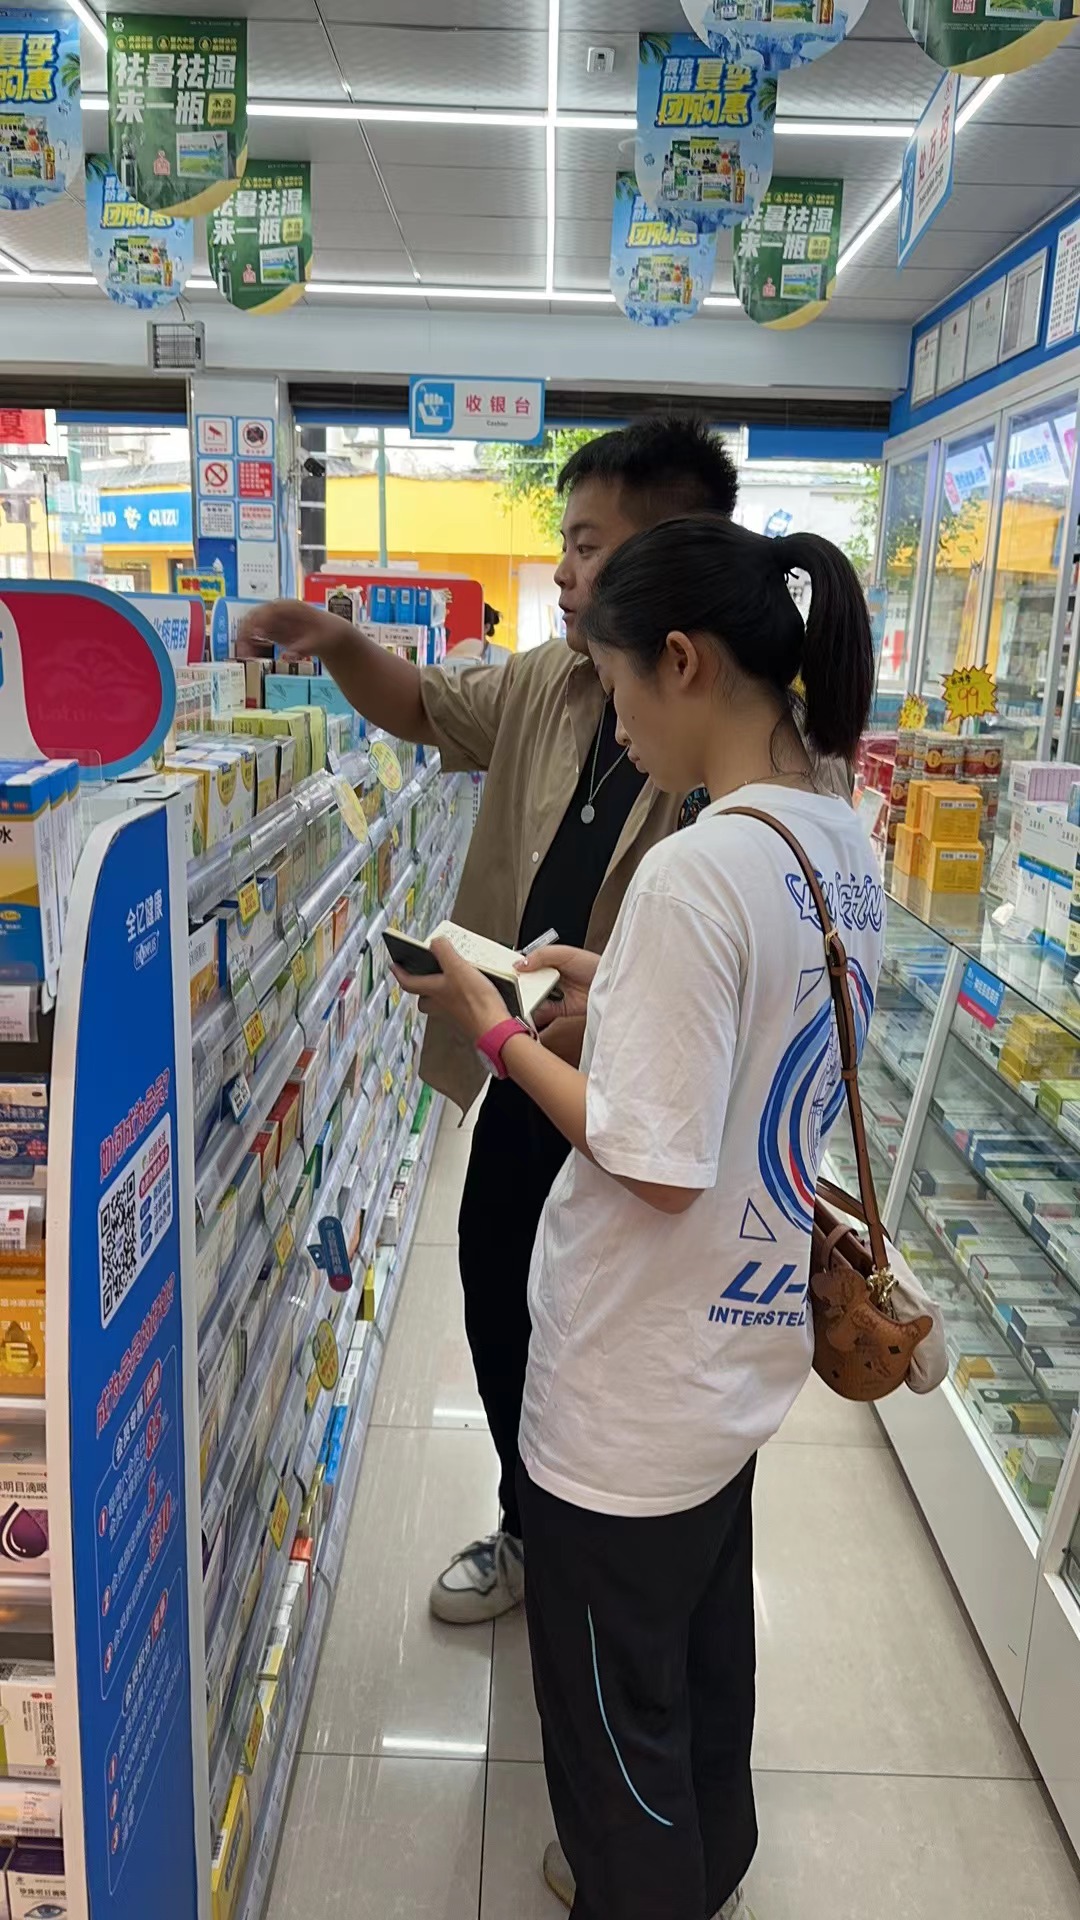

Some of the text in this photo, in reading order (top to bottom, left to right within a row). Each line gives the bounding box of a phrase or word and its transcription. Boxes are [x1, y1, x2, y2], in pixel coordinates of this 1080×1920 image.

[116, 52, 236, 89] 祛暑祛湿
[116, 89, 205, 125] 来一瓶
[659, 91, 749, 126] 团购惠
[917, 104, 950, 186] 处方药
[213, 218, 281, 245] 来一瓶
[738, 232, 809, 260] 来一瓶
[465, 394, 531, 415] 收银台
[148, 508, 179, 528] GUIZU
[957, 686, 979, 713] 99
[125, 888, 164, 943] 全亿健康
[99, 1067, 170, 1184] 如何成为会员?
[720, 1260, 807, 1305] LI-
[708, 1305, 806, 1327] INTERSTEL
[0, 1481, 48, 1493] 明目滴眼
